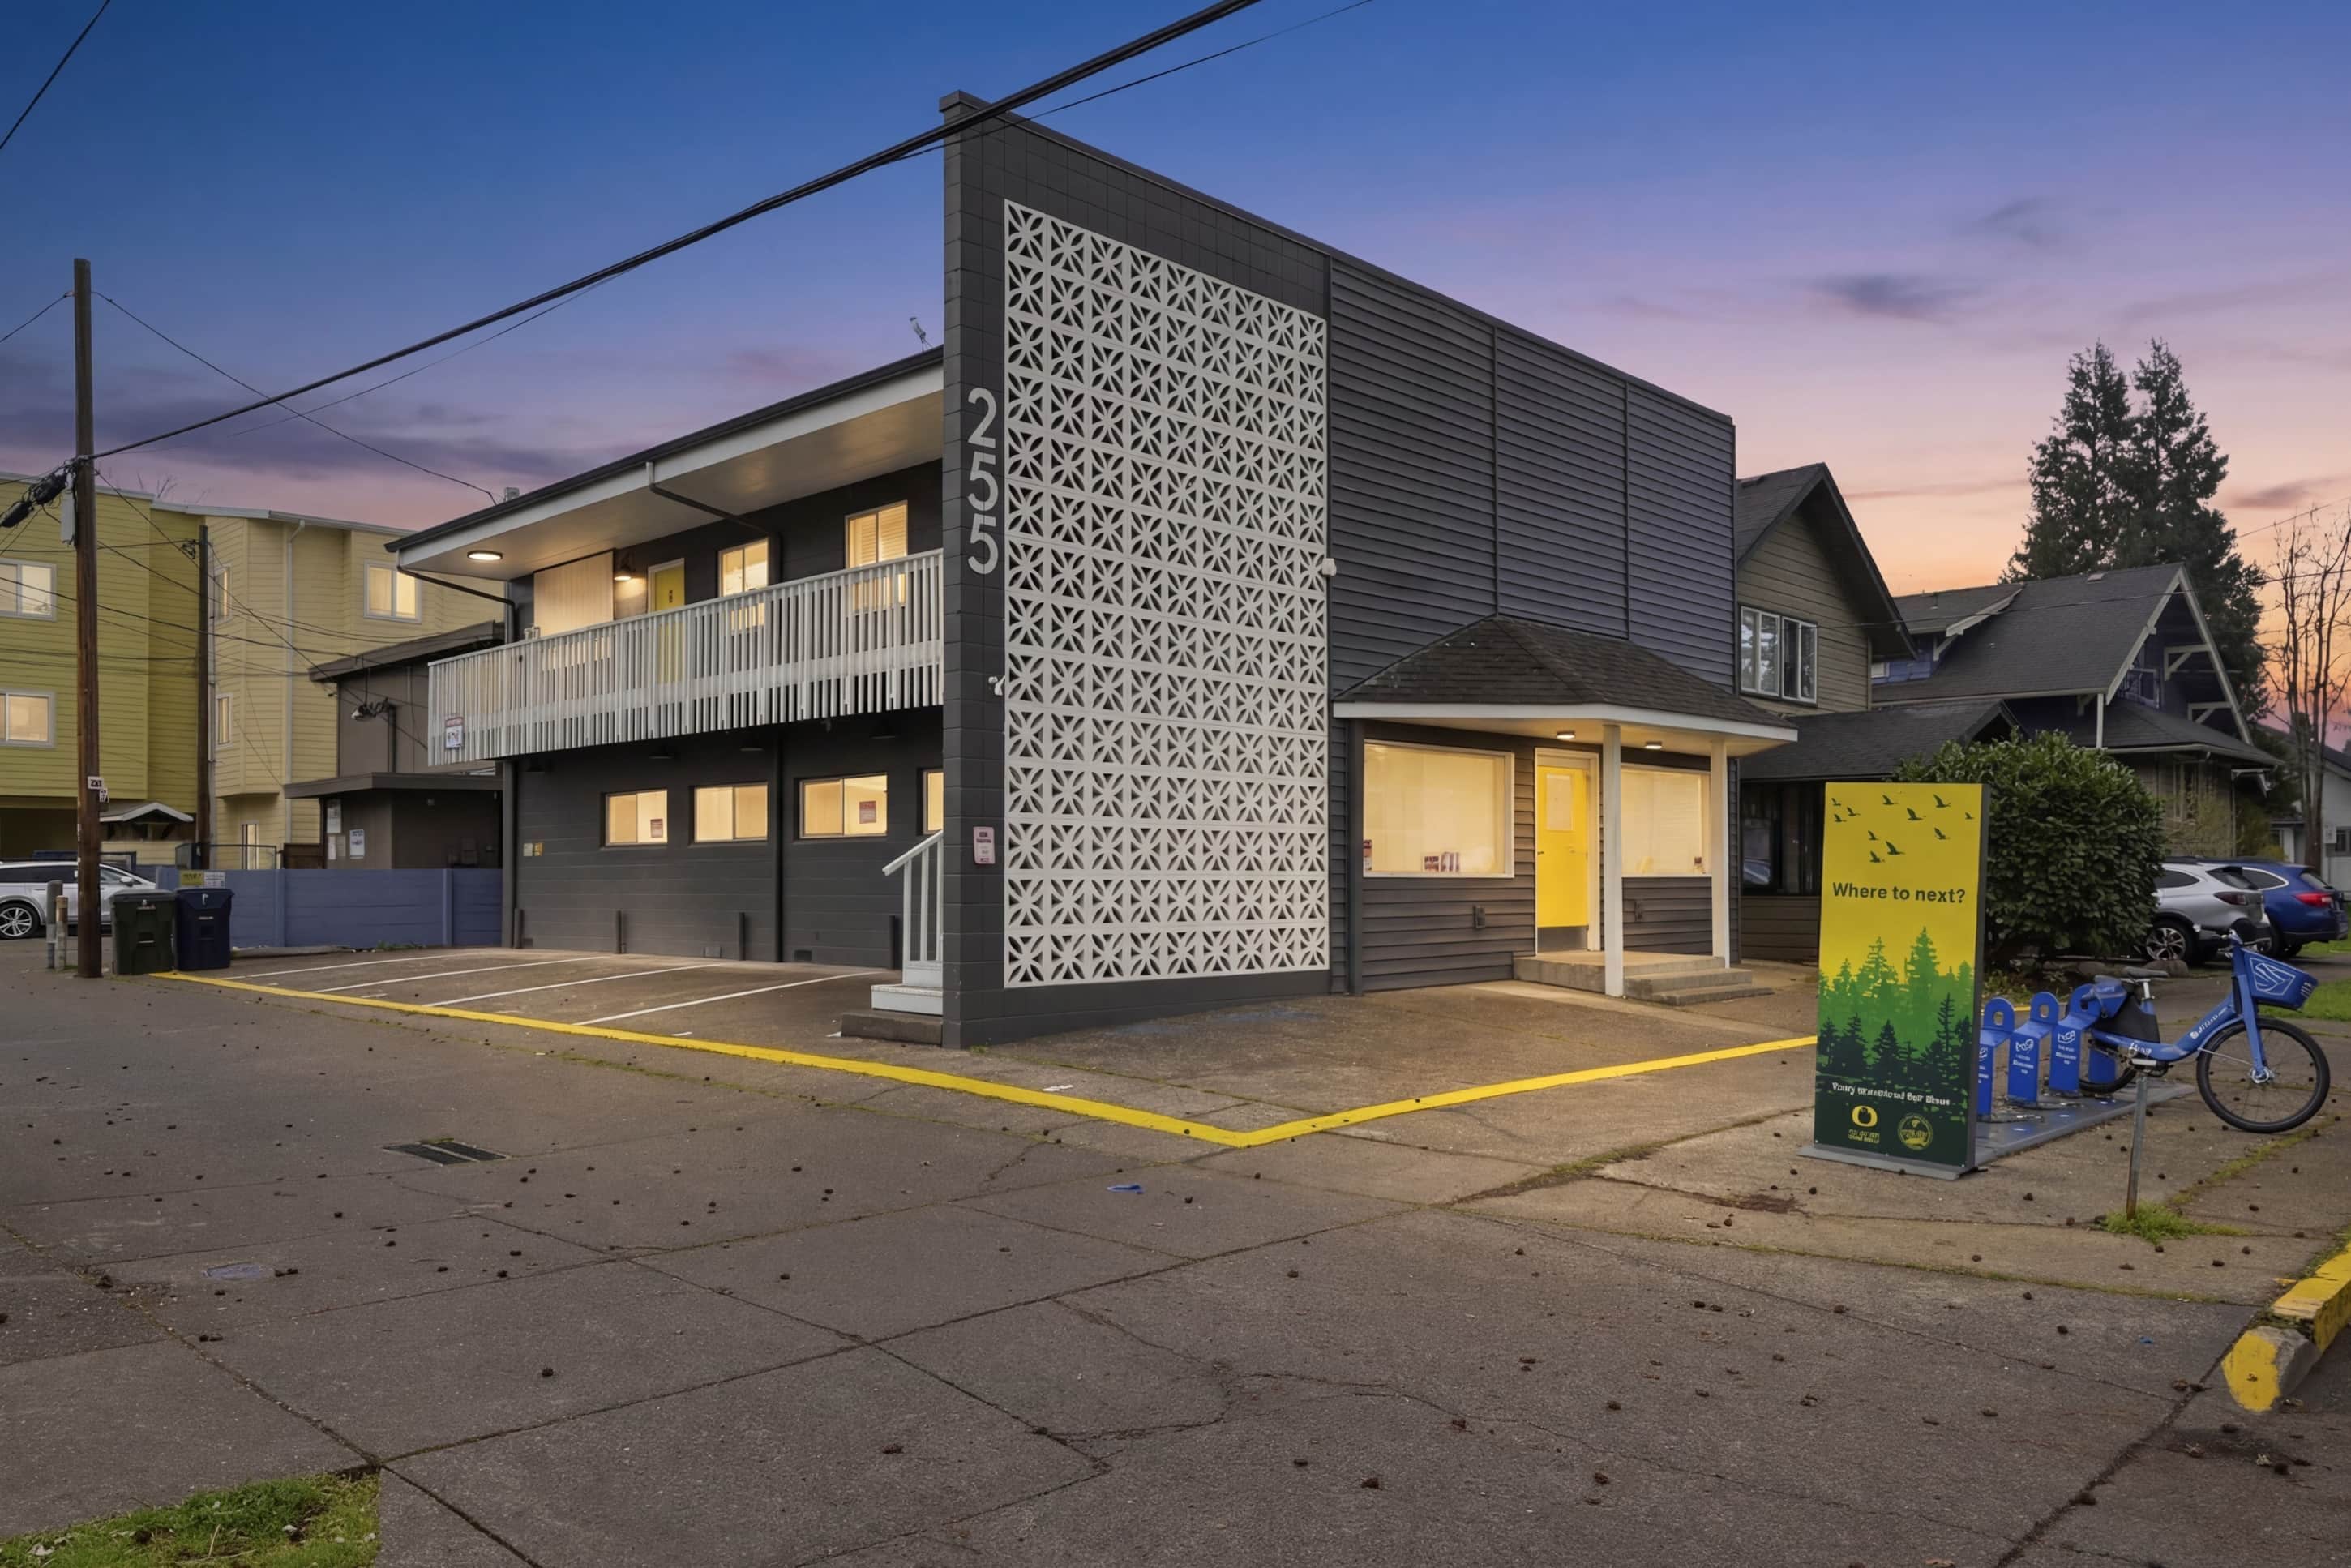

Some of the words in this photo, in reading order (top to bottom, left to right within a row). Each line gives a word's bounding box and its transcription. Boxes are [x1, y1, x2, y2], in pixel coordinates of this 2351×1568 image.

[967, 387, 999, 575] 255
[1832, 882, 1887, 899] Where
[1892, 886, 1910, 900] to
[1916, 889, 1966, 903] next?
